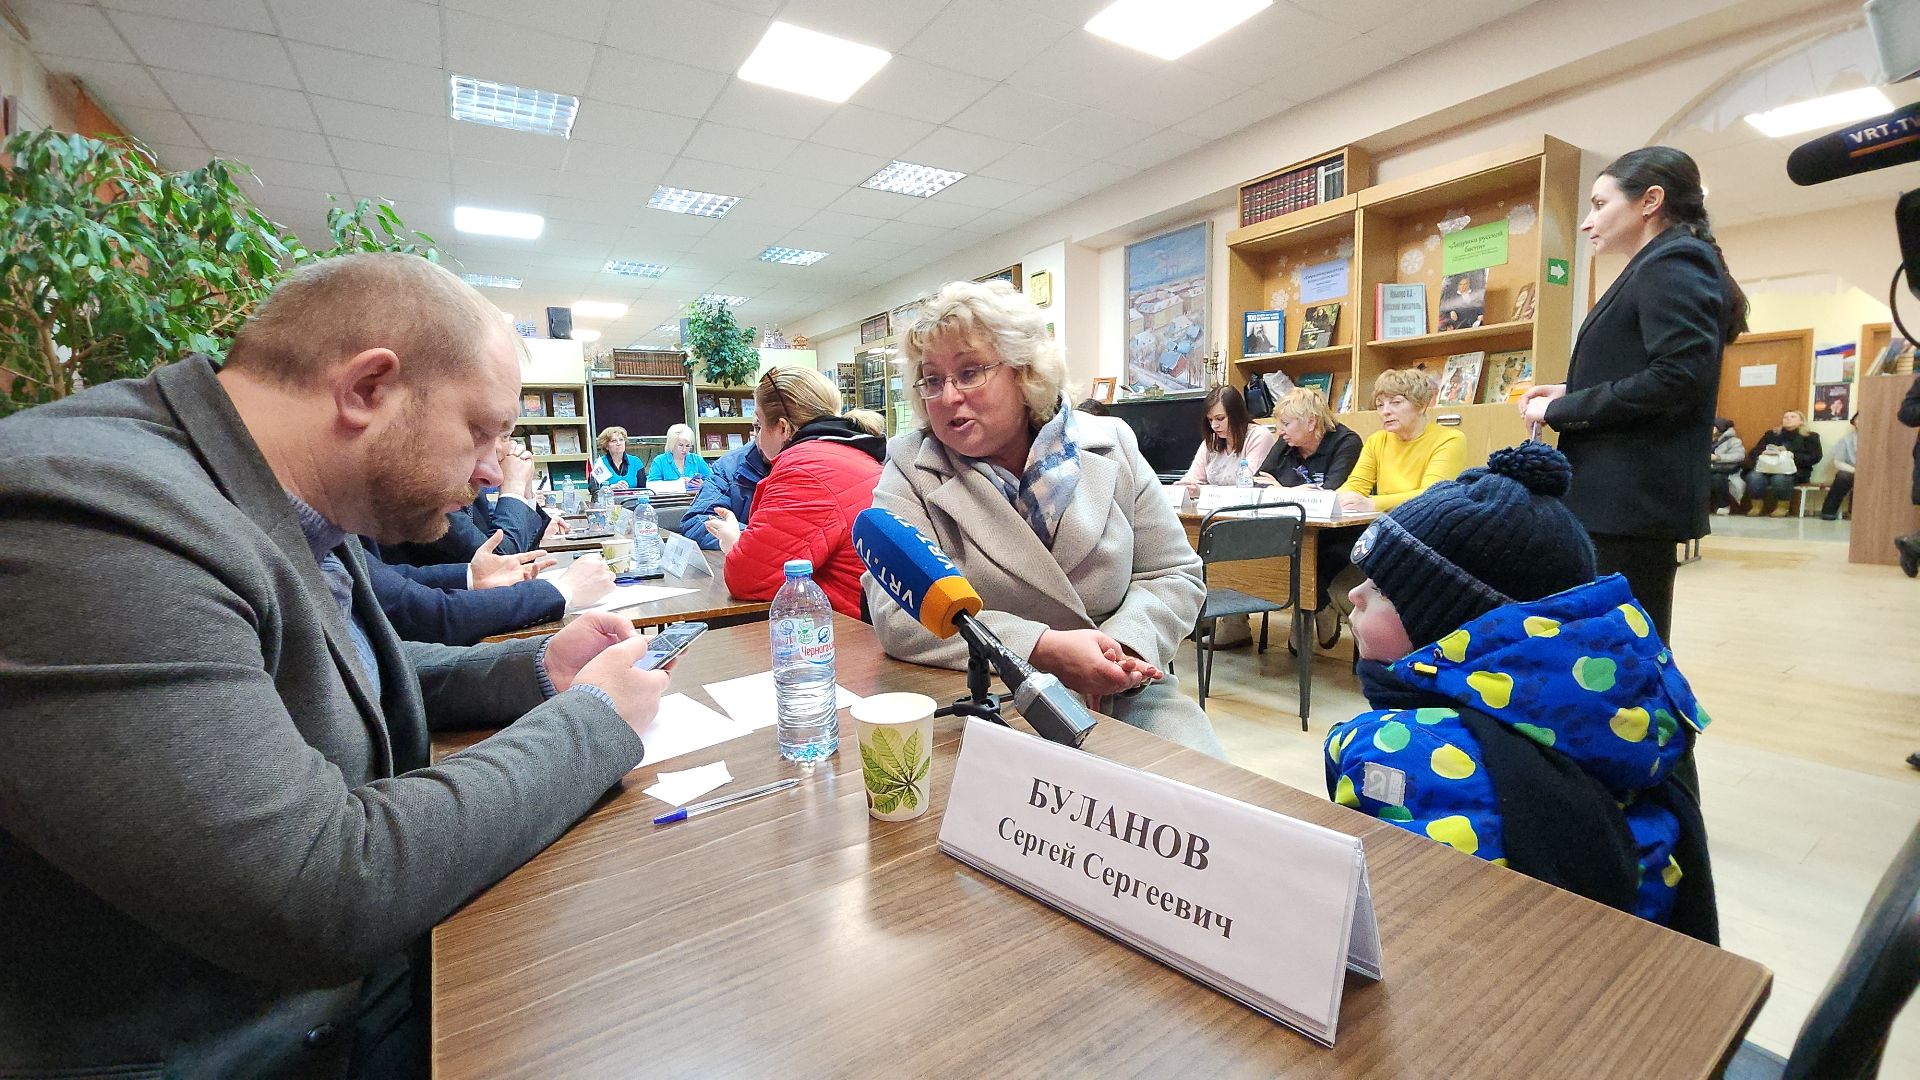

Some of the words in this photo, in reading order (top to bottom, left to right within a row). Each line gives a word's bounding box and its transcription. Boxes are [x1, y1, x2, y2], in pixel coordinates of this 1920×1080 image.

[856, 537, 914, 609] VRT.TV
[1027, 777, 1211, 871] БУЛАНОВ
[998, 816, 1077, 869] Сергей
[1083, 852, 1233, 940] Сергеевич
